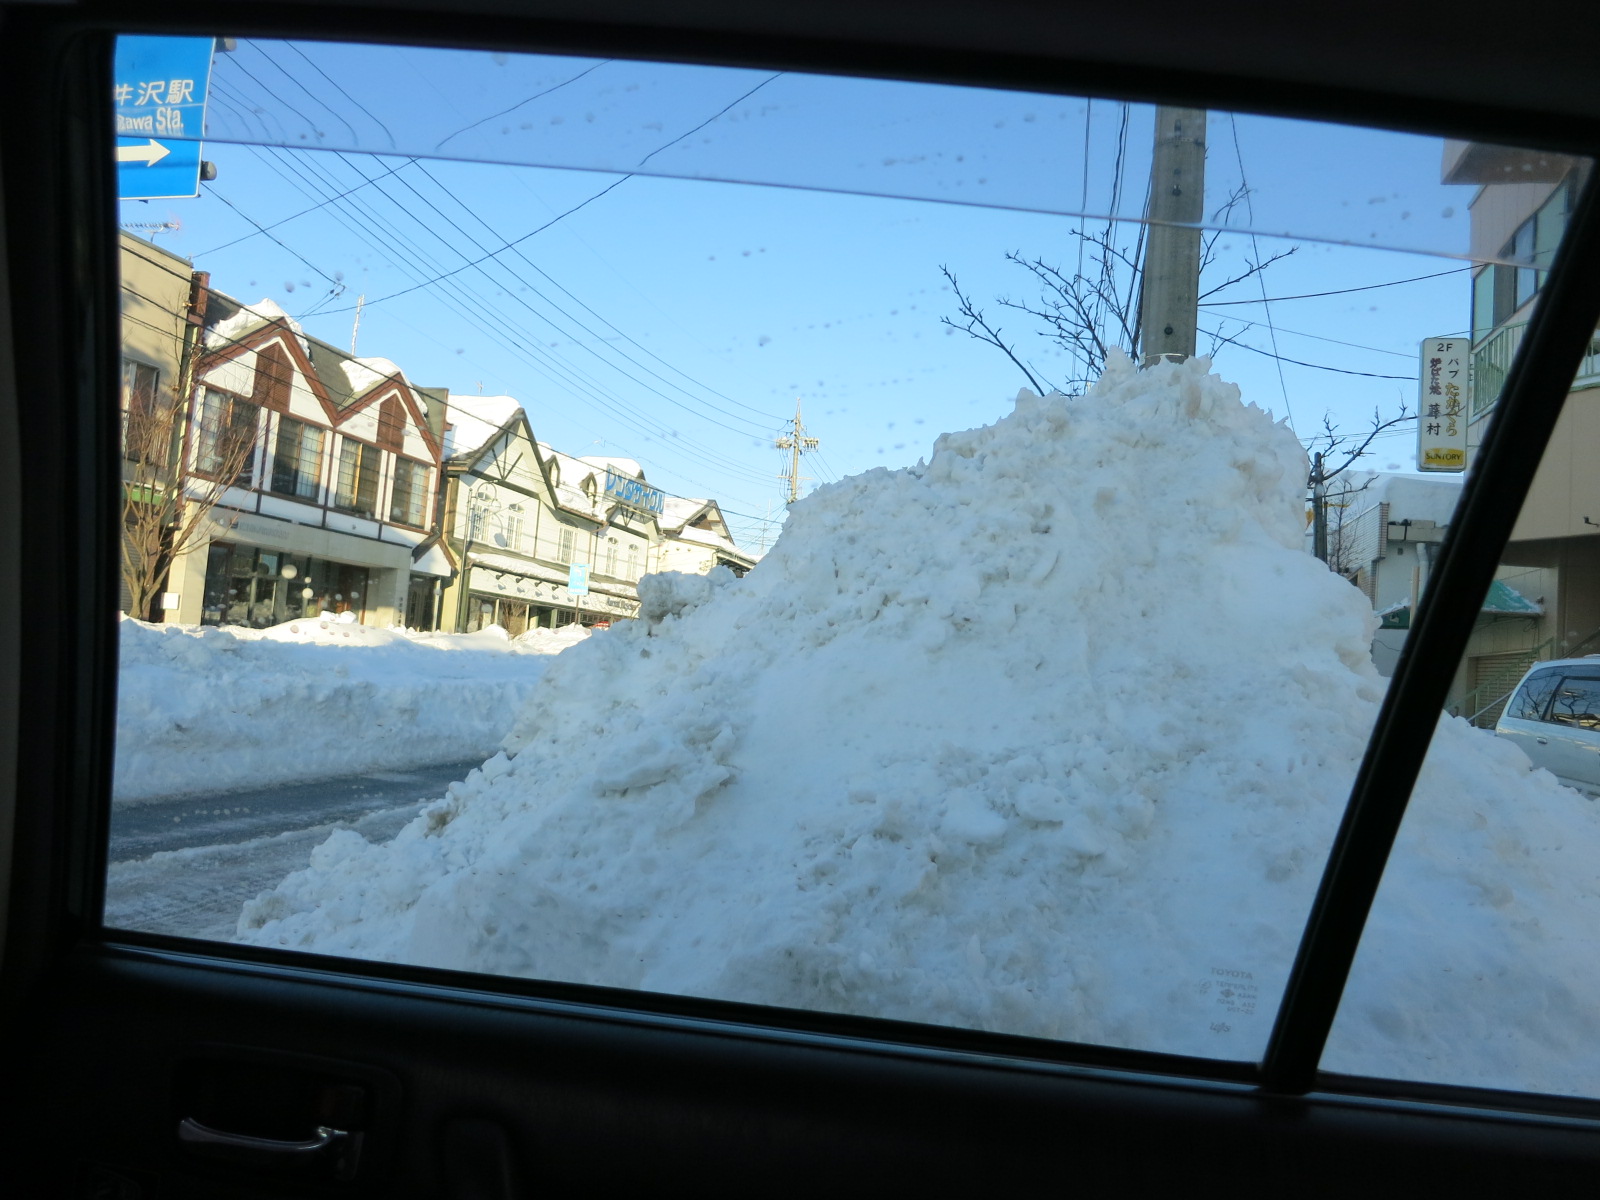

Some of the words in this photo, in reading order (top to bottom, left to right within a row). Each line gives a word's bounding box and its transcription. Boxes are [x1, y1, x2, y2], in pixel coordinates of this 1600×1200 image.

[115, 79, 194, 106] 井沢駅
[156, 107, 184, 131] Sta.
[1437, 343, 1453, 352] 2F
[1425, 452, 1462, 461] SUNTORY
[605, 468, 664, 514] レンタサイクル
